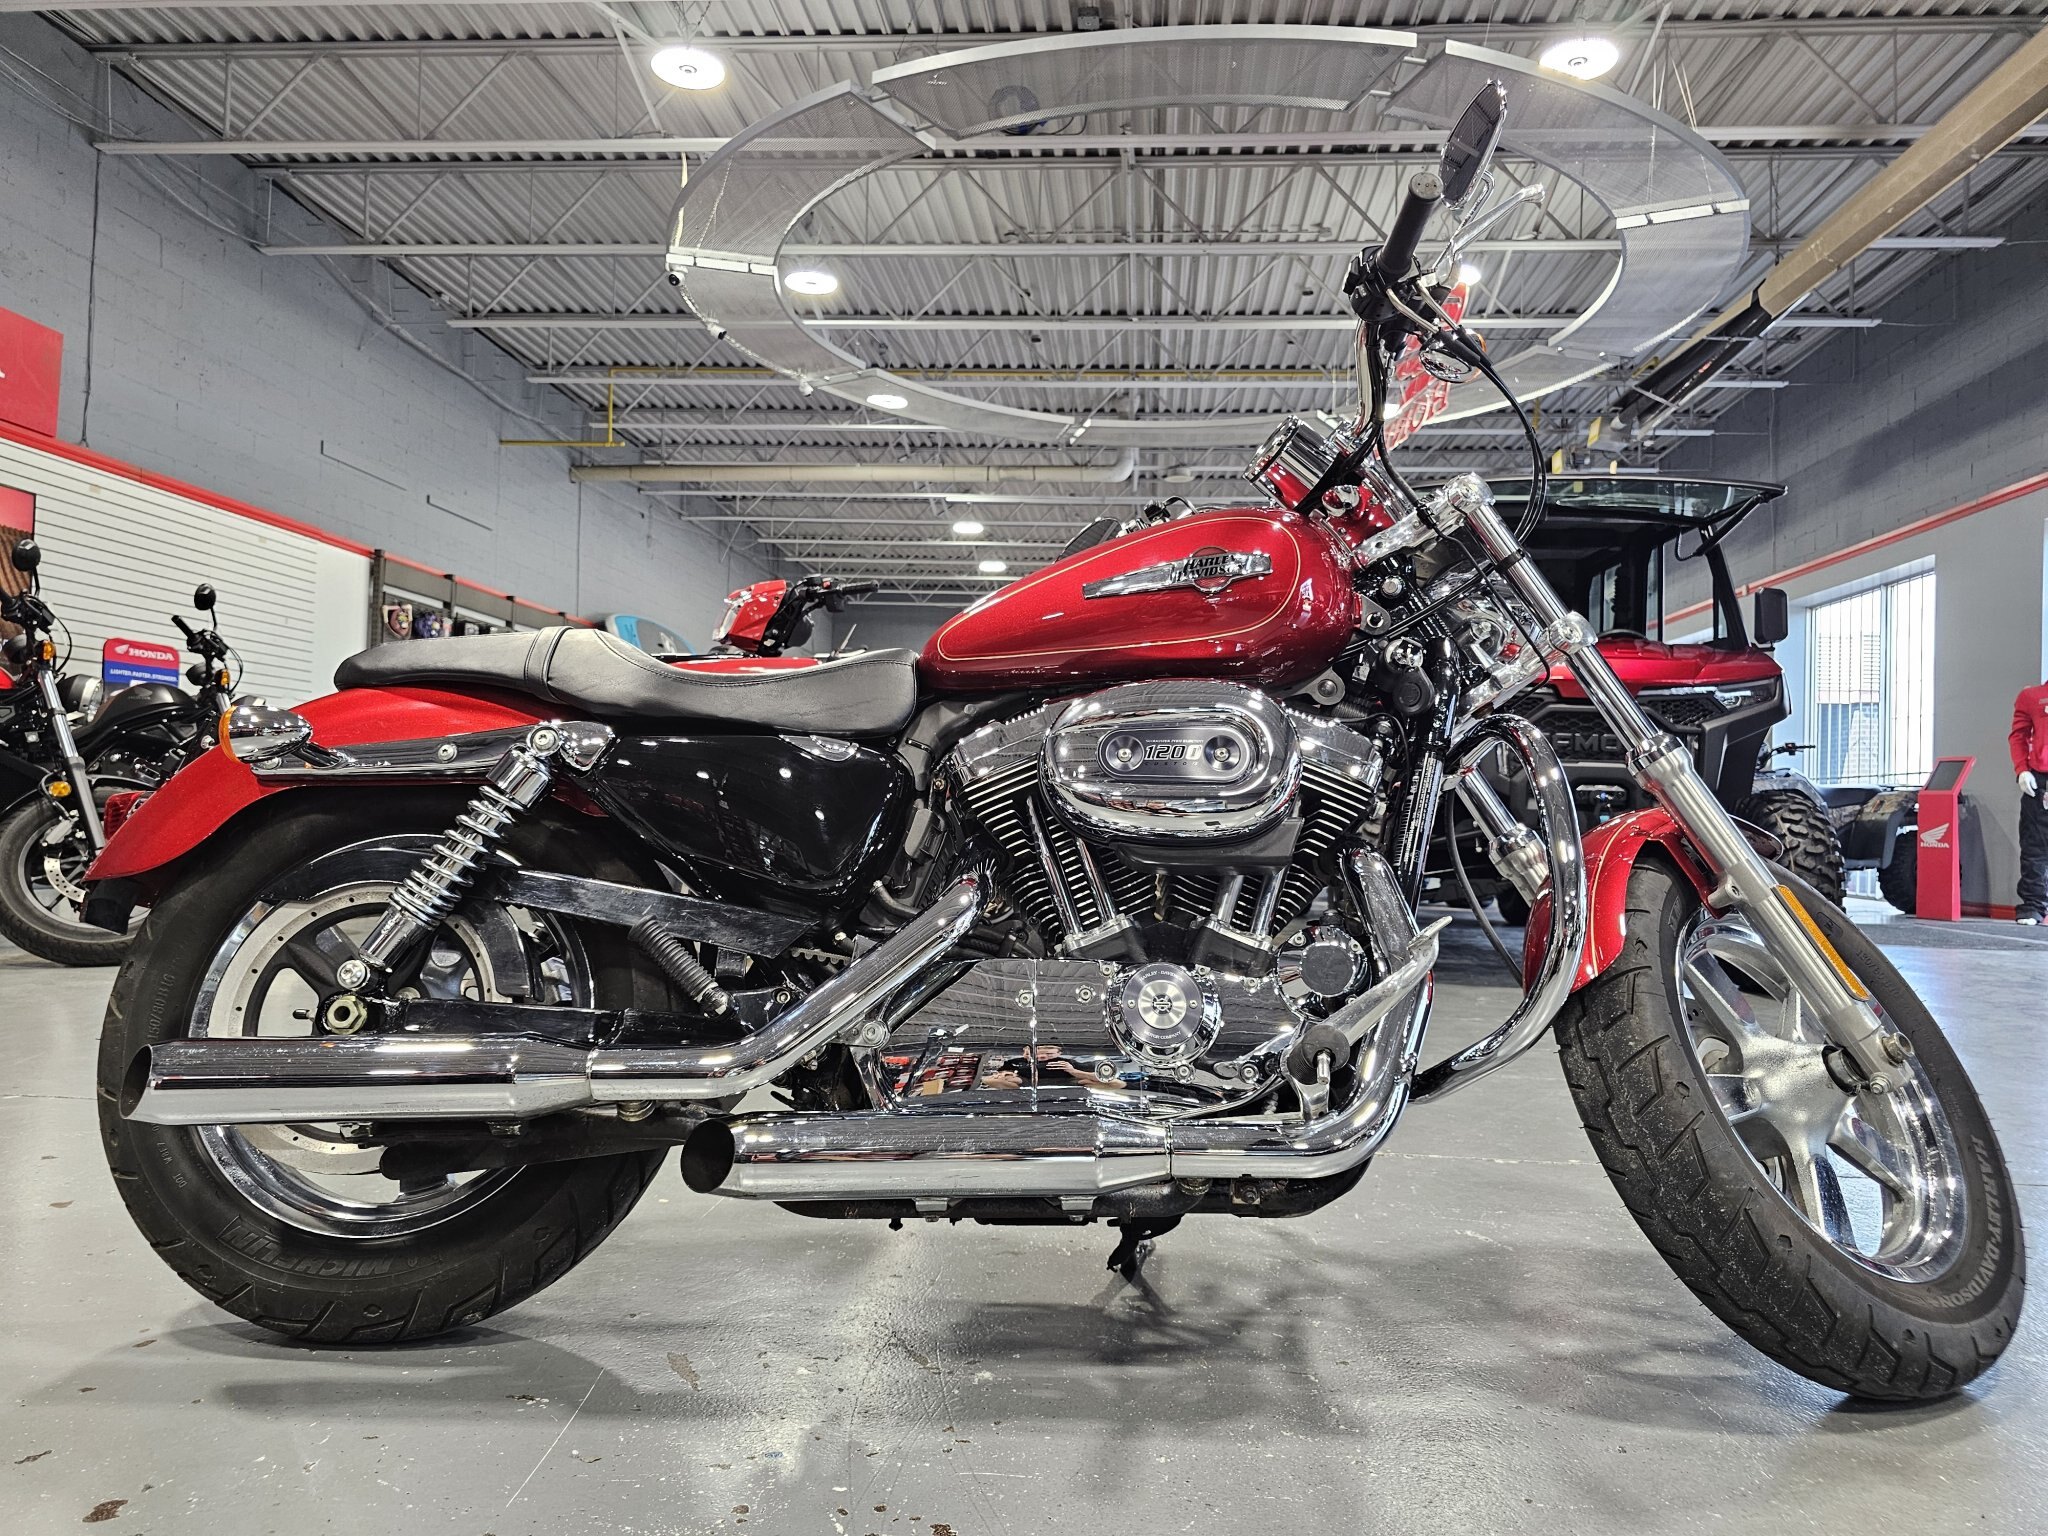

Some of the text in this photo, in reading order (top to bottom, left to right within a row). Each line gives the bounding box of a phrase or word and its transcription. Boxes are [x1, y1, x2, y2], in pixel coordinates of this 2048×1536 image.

[1184, 554, 1236, 572] HARLEY
[128, 648, 175, 661] HONDA
[1144, 744, 1203, 760] 1200
[1920, 841, 1950, 849] HONDA
